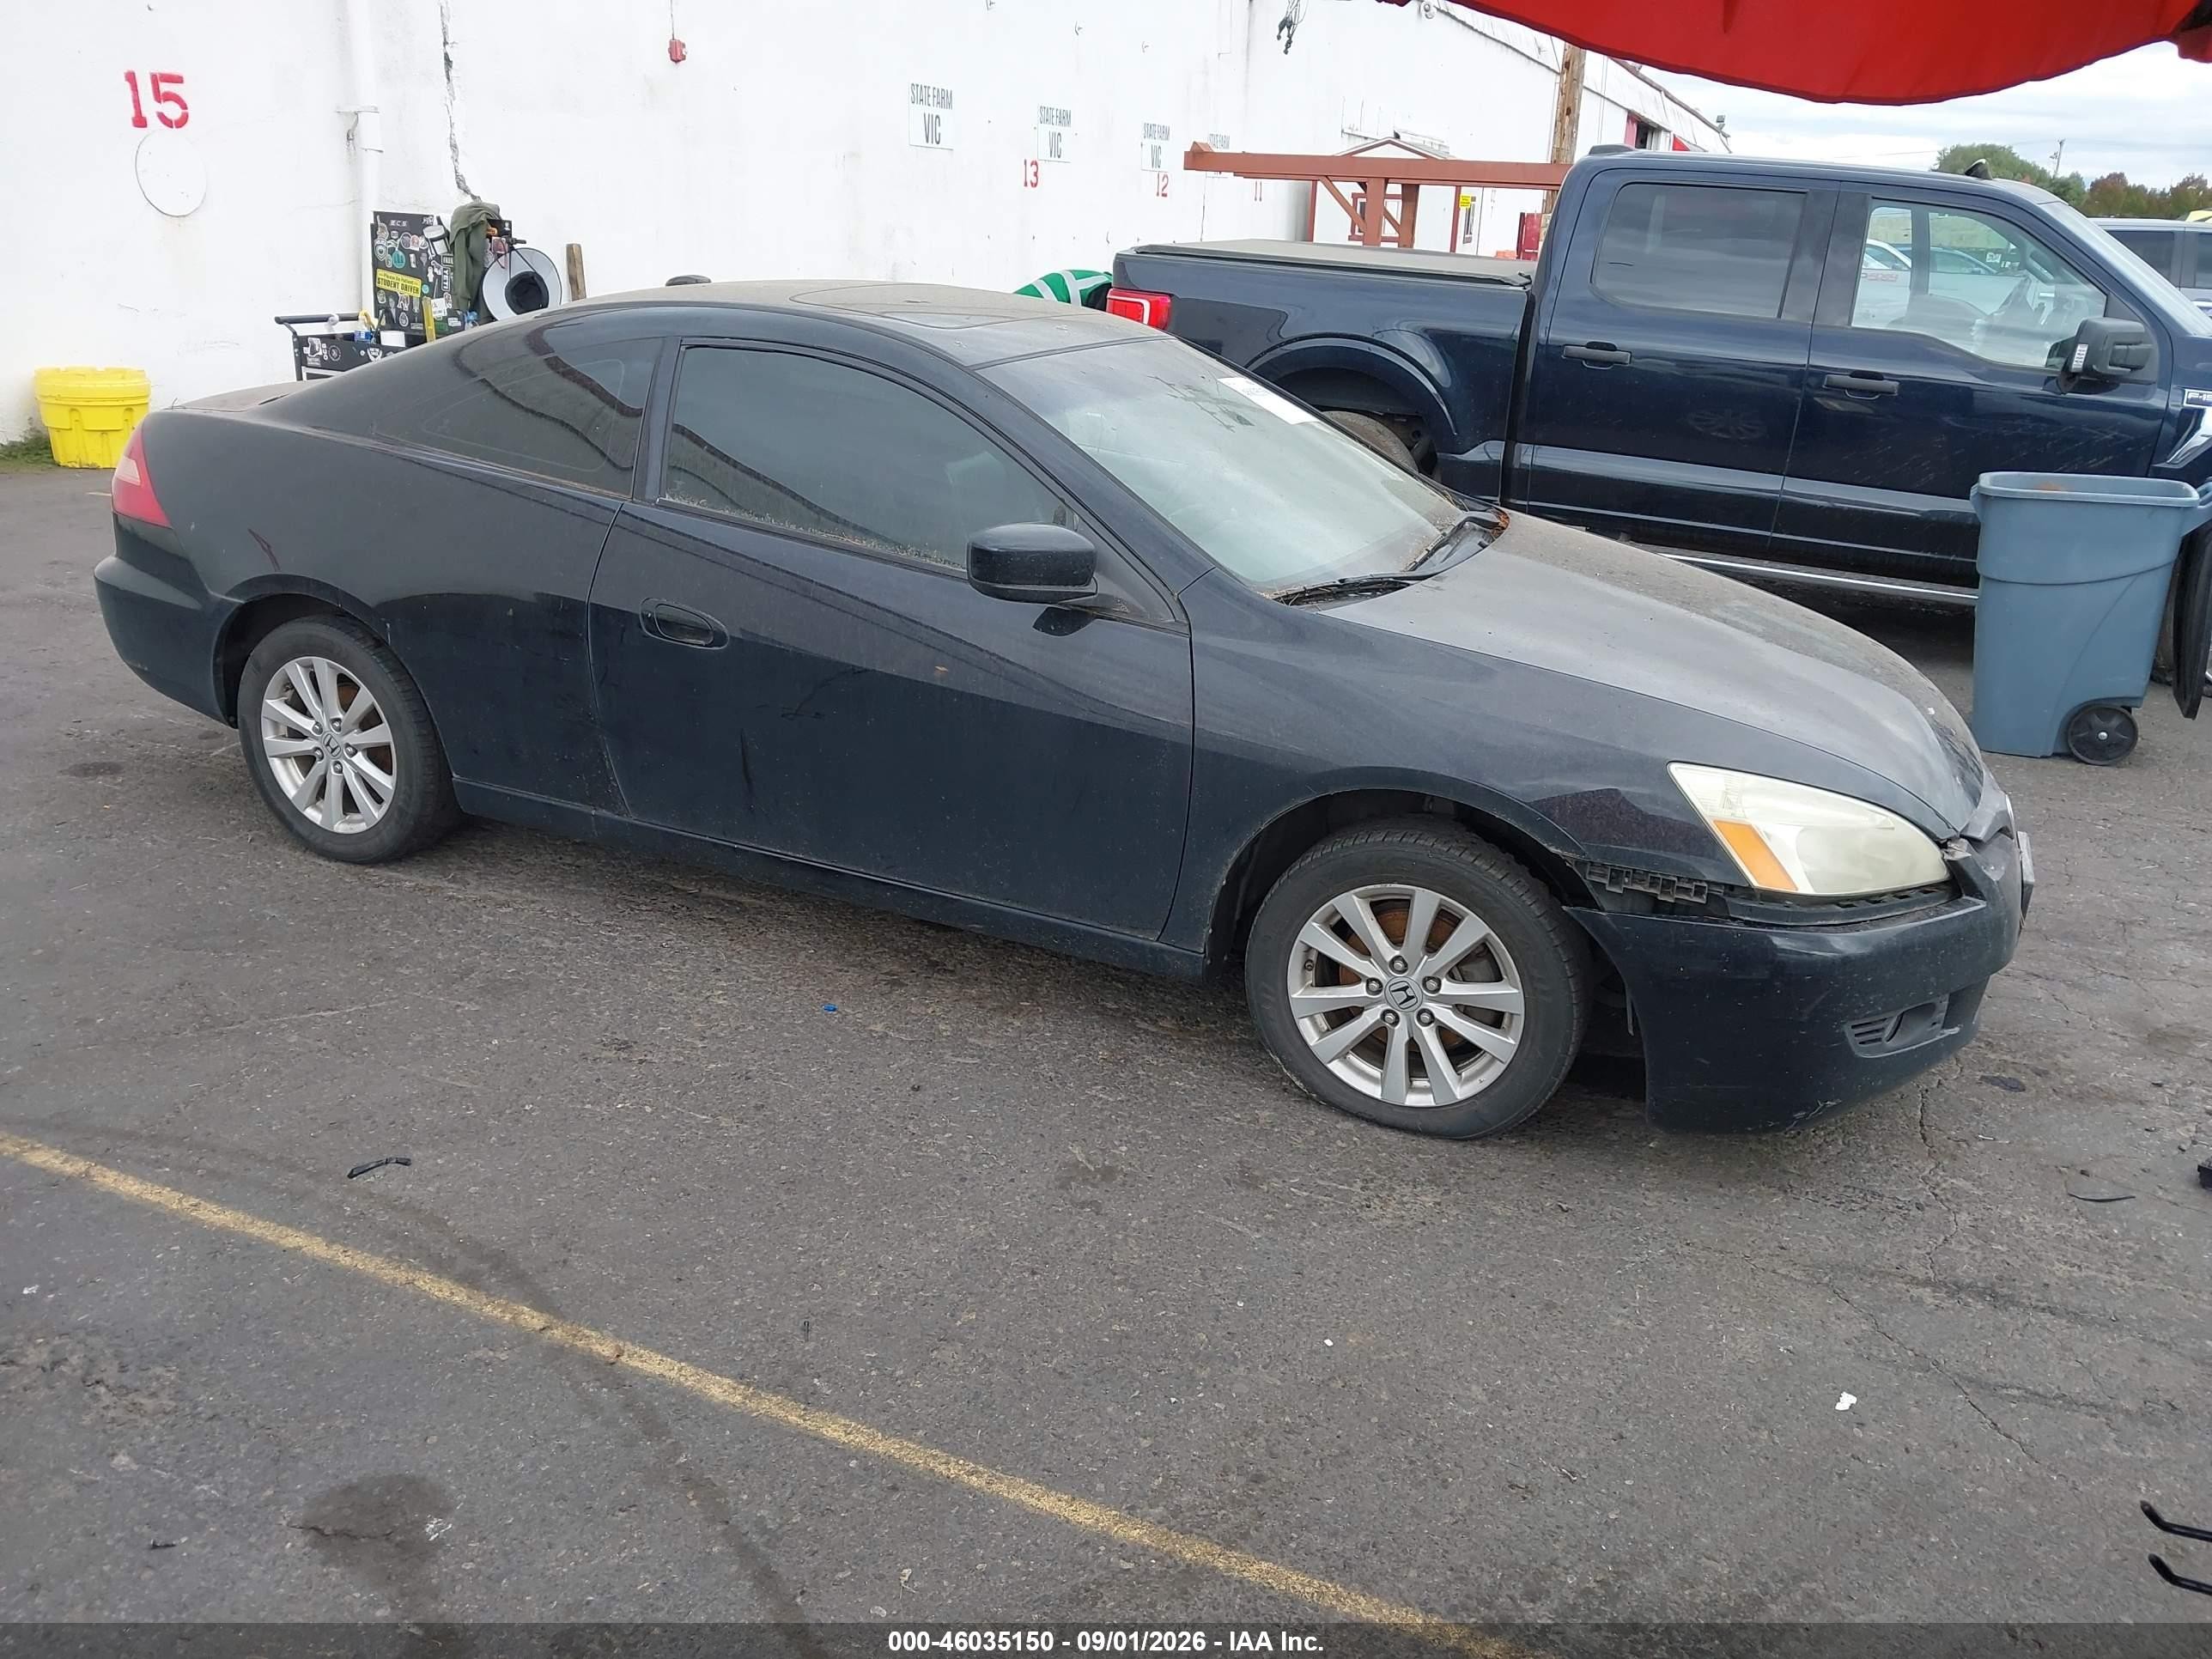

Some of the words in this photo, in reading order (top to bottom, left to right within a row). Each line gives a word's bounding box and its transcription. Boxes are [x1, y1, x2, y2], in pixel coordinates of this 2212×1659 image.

[124, 70, 189, 129] 15
[910, 82, 931, 106] STATE
[933, 86, 953, 110] FARM
[923, 112, 941, 145] VIC
[1039, 105, 1054, 125] STATE
[1055, 107, 1072, 128] FARM
[1048, 130, 1062, 159] VIC
[1143, 122, 1157, 140] STATE
[1157, 124, 1170, 141] FARM
[1151, 143, 1162, 169] VIC
[1023, 158, 1039, 188] 13
[1156, 173, 1170, 198] 12
[377, 276, 399, 289] STUDENT
[400, 283, 420, 295] DRIVER
